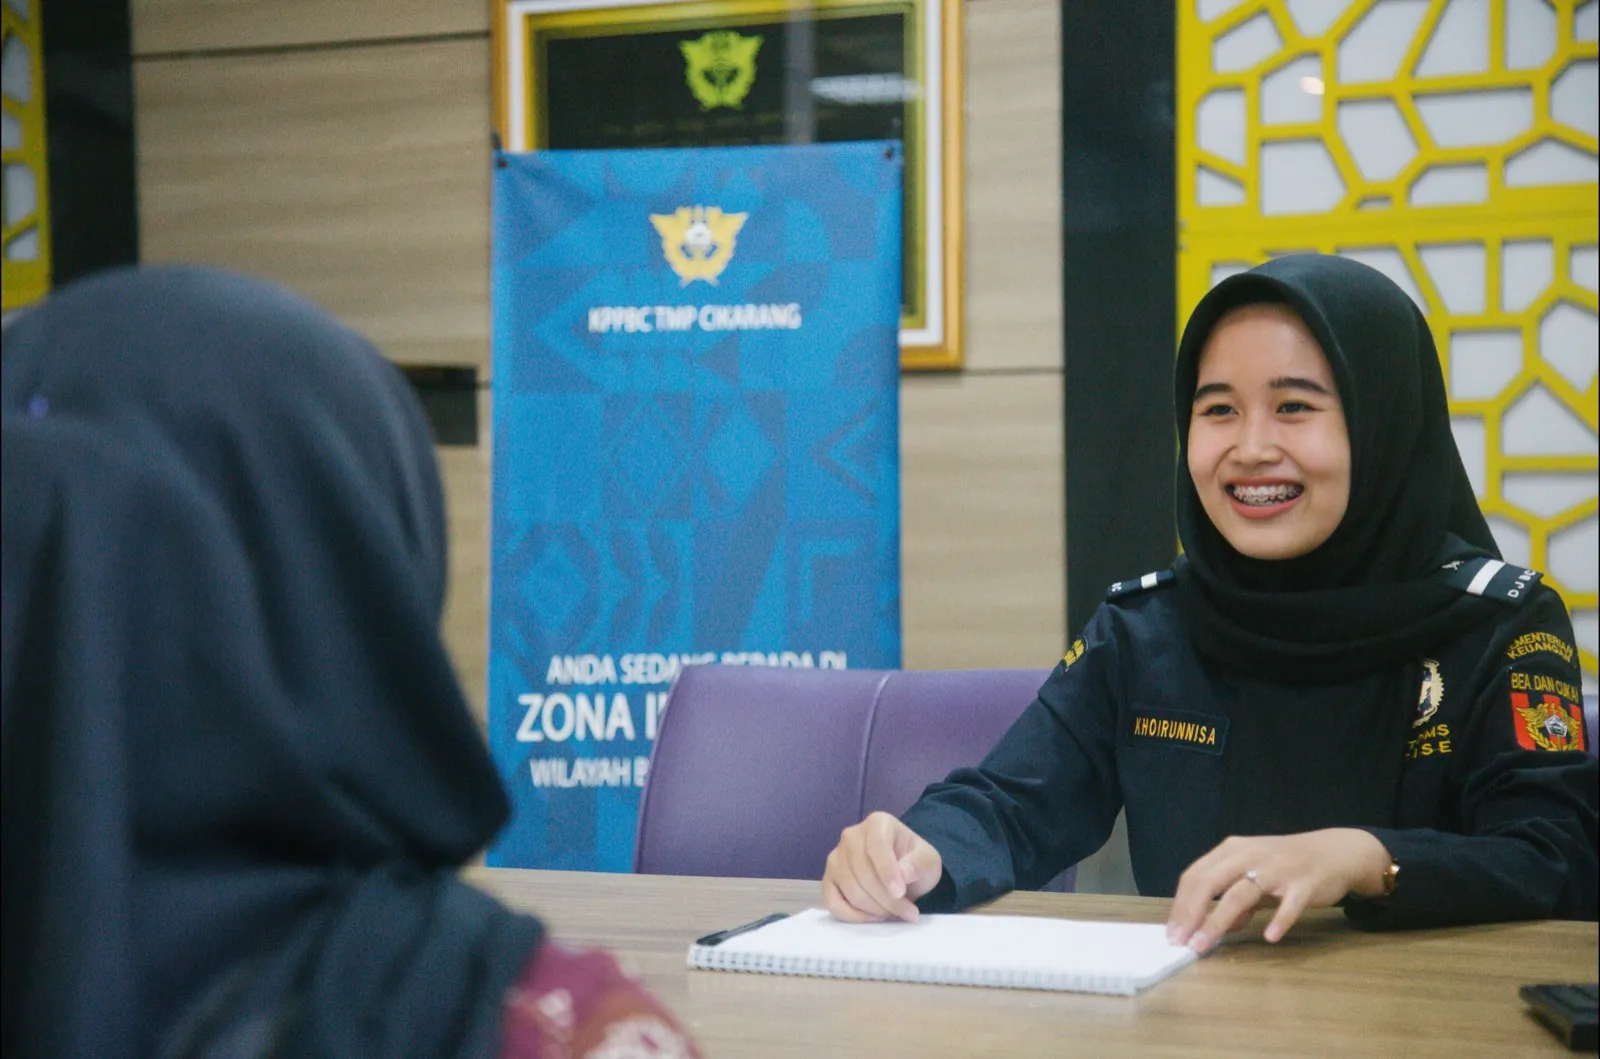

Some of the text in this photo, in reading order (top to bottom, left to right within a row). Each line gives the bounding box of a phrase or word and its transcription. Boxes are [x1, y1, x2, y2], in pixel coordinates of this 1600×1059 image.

[588, 303, 802, 333] KPPBC TMP CIKARANG
[547, 655, 617, 685] ANDA
[620, 652, 717, 684] SEDA
[1511, 672, 1531, 690] BEA
[1533, 675, 1555, 692] DAN
[516, 692, 636, 742] ZONA
[1134, 717, 1216, 745] KHOIRUNNISA
[530, 757, 631, 787] WILAYAH
